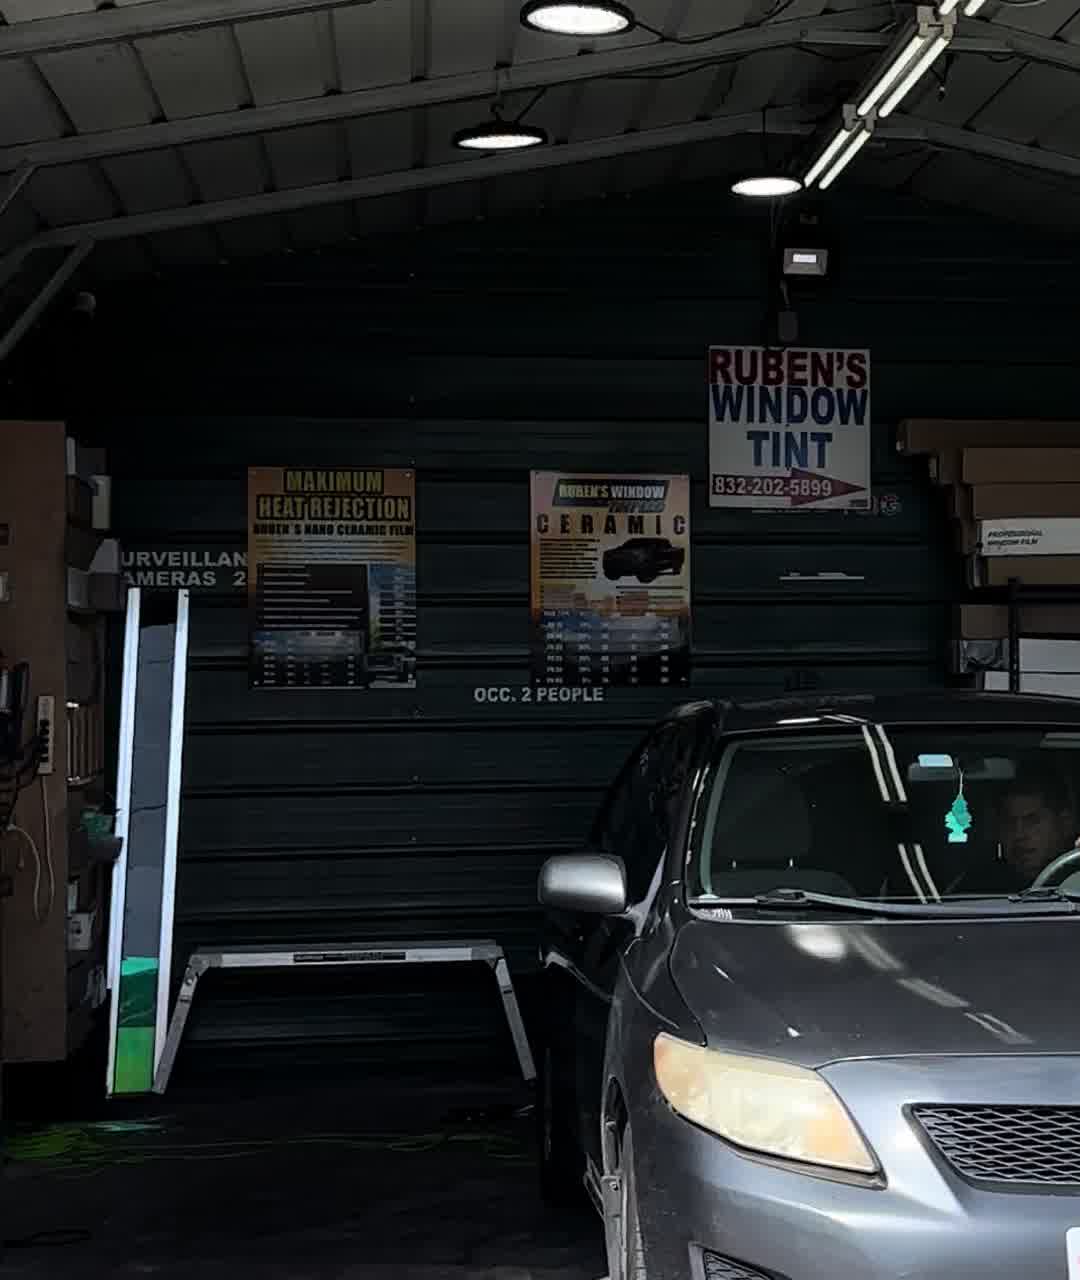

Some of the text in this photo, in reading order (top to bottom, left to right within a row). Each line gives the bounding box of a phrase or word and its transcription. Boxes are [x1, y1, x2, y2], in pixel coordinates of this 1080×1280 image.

[710, 351, 867, 388] RUBEN'S
[711, 385, 867, 425] WINDOW
[747, 431, 833, 468] TINT
[611, 486, 665, 499] WINDOW
[714, 477, 833, 496] 832-202-5899
[259, 497, 409, 520] HEAT REJECTION
[537, 515, 687, 535] CERAMIC
[125, 570, 217, 587] AMERAS
[473, 688, 605, 703] OCC. 2 PEOPLE
